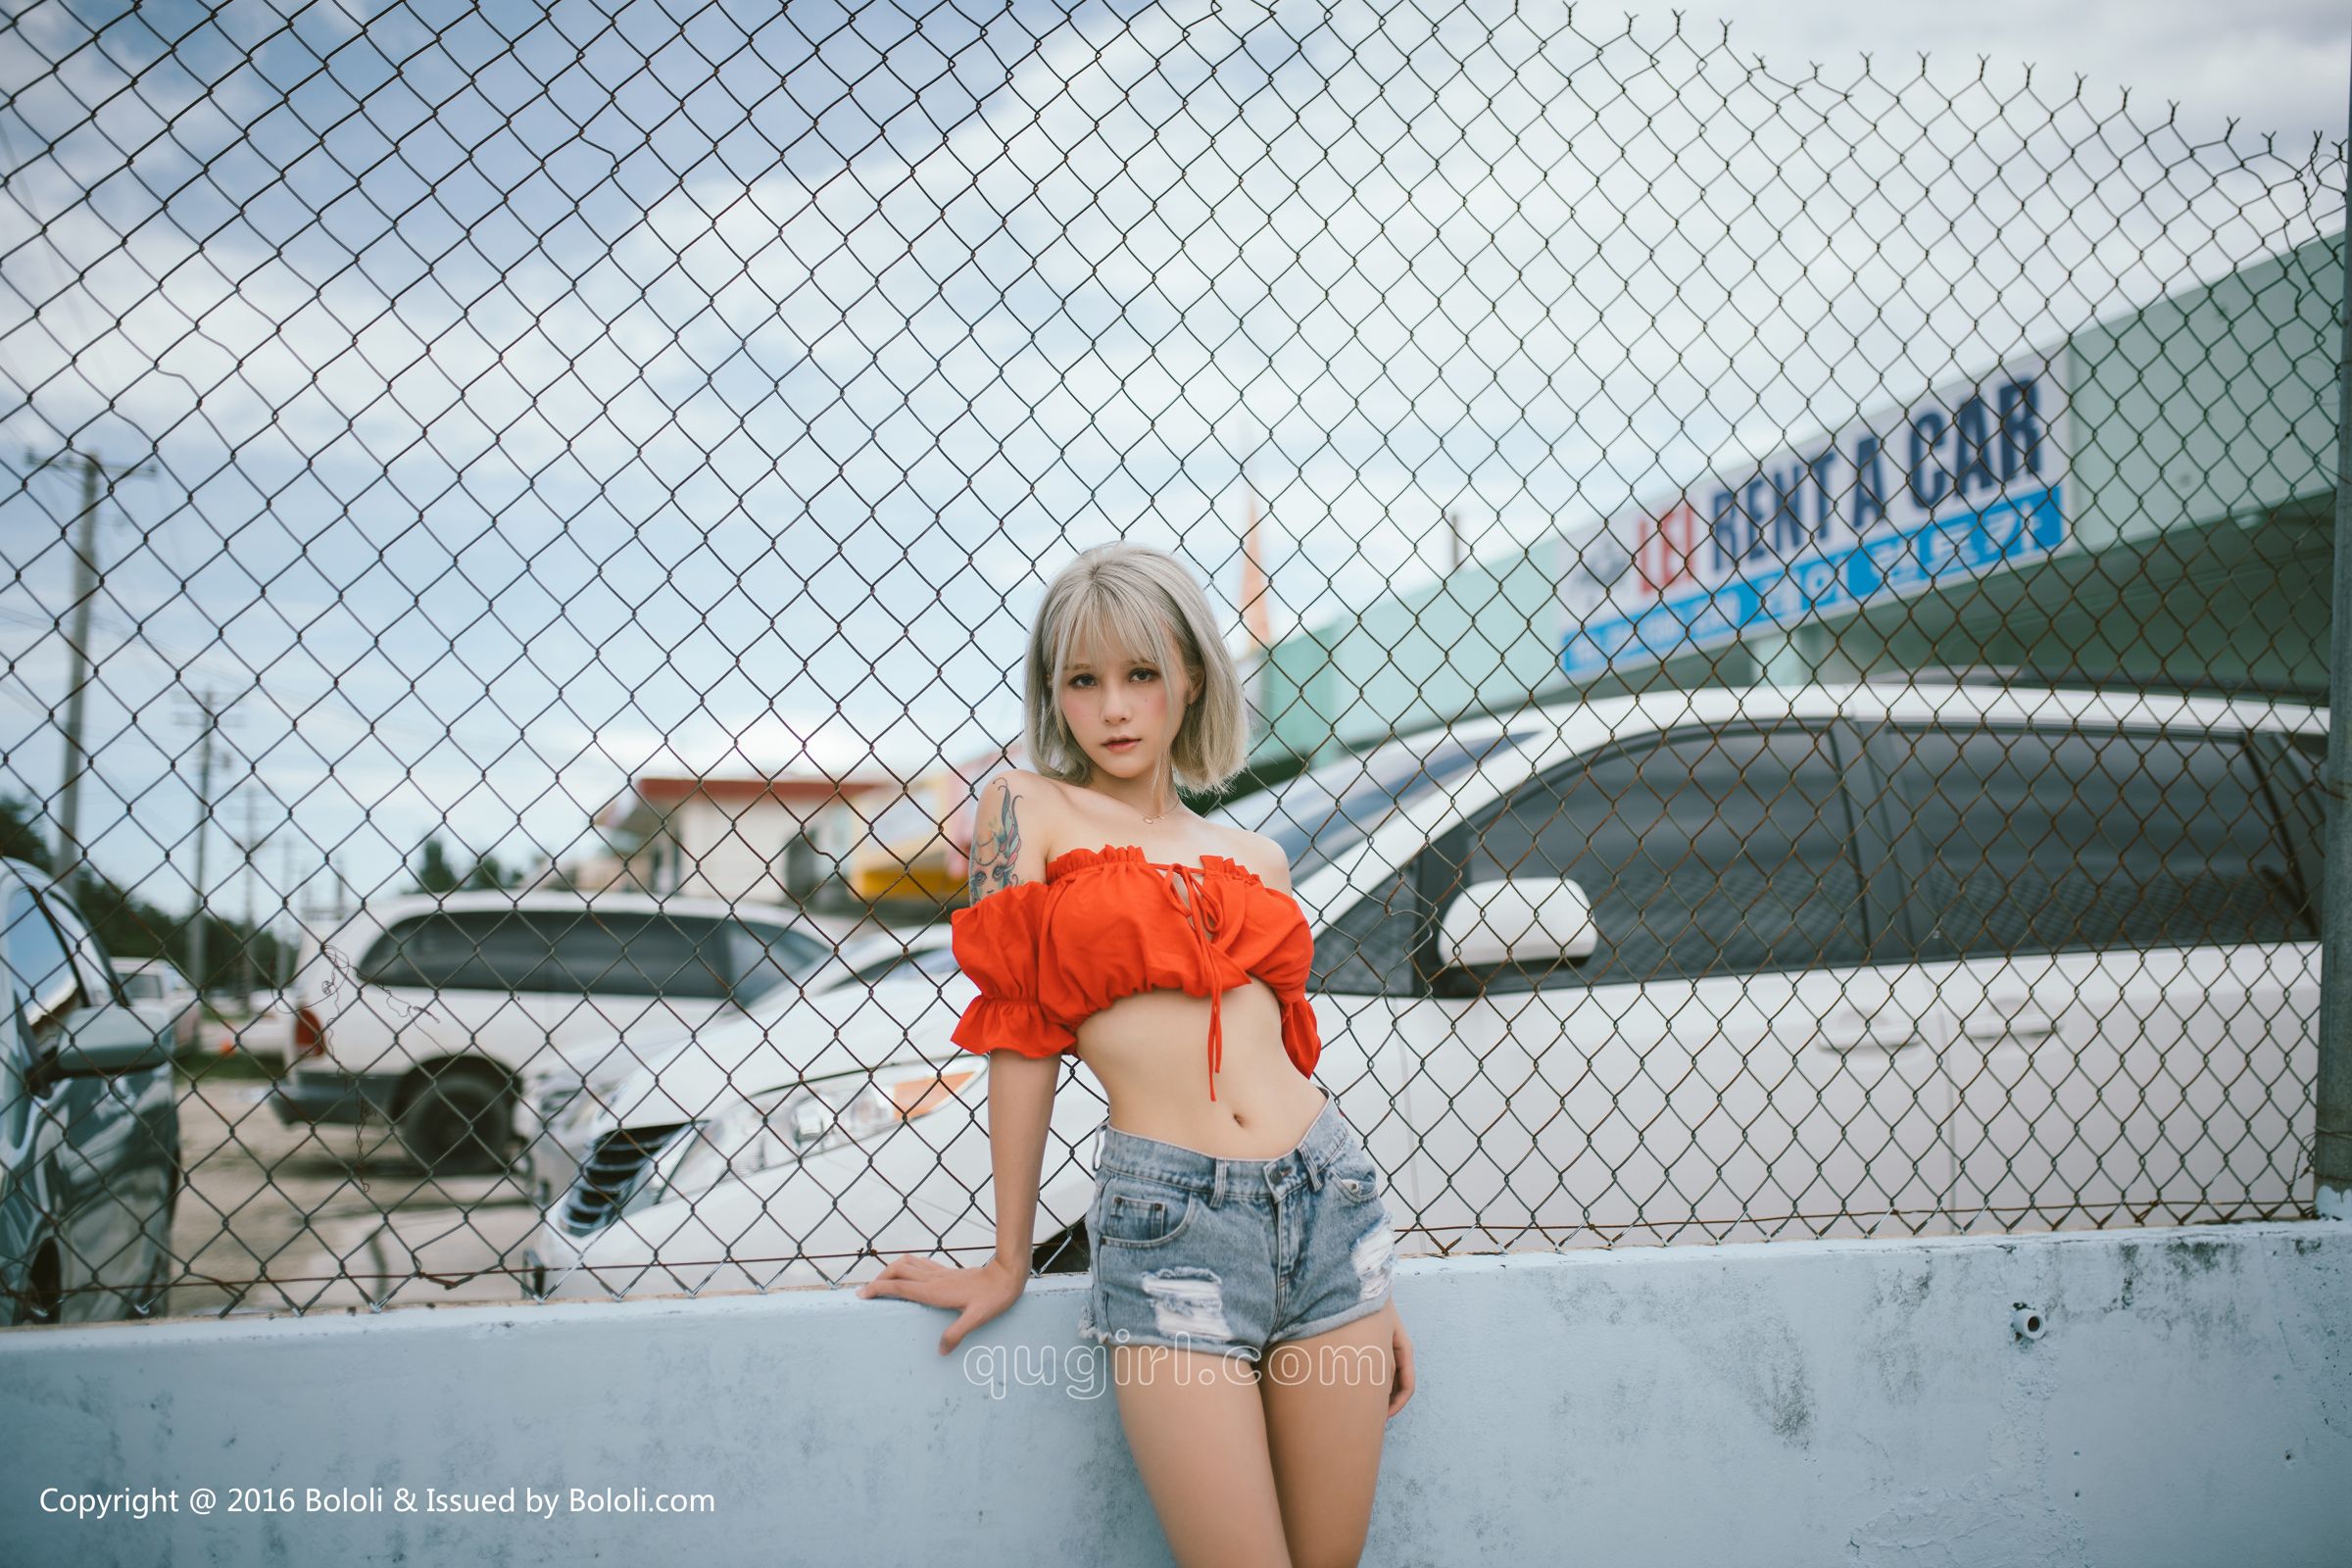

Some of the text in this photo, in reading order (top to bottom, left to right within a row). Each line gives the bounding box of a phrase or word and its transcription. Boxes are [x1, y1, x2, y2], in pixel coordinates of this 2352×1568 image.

[1713, 451, 1837, 571] RENT
[1853, 436, 1886, 528] A
[1909, 377, 2042, 509] CAR
